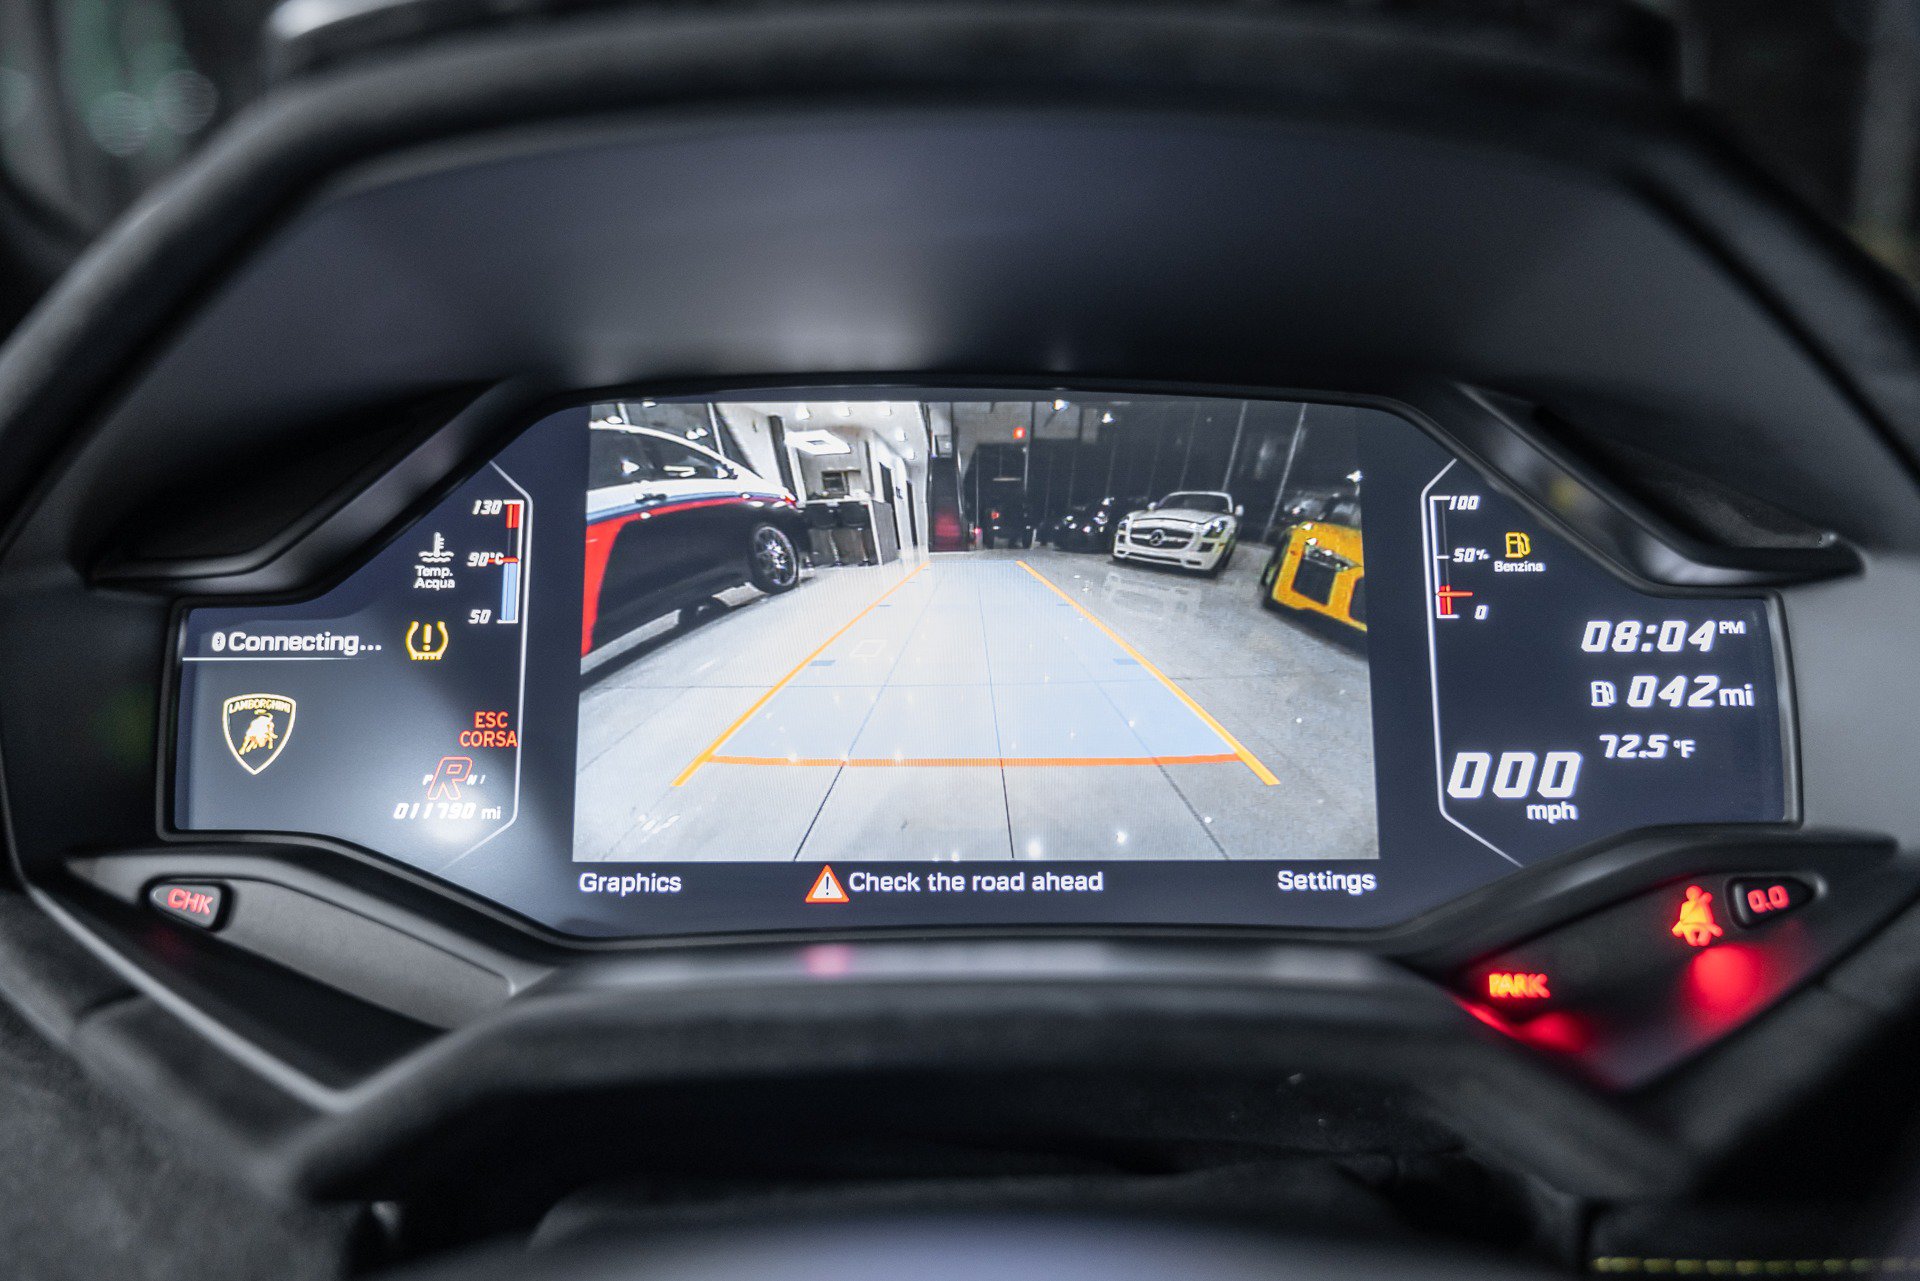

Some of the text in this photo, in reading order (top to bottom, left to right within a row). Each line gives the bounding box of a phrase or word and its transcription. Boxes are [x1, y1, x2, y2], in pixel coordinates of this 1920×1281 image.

[472, 499, 502, 515] 130
[1449, 495, 1480, 511] 100
[1453, 547, 1489, 563] 50%
[415, 565, 453, 578] Temp.
[1493, 560, 1546, 572] Benzina
[413, 578, 456, 591] Acqua
[468, 609, 491, 624] 50
[1475, 604, 1489, 620] 0
[228, 631, 382, 656] Connecting...
[1581, 620, 1747, 652] 08:04 PM
[1626, 675, 1755, 707] 042 mi
[229, 699, 291, 714] LAMBORGHINI
[474, 711, 509, 729] ESC
[459, 730, 518, 748] CORSA
[1599, 734, 1669, 758] 72.5
[427, 756, 473, 801] R
[1447, 752, 1583, 798] 000
[393, 802, 502, 820] 011790 mi
[1526, 801, 1579, 824] mph
[579, 872, 682, 897] Graphics
[849, 871, 1104, 892] Check the road ahead
[1277, 870, 1377, 895] Settings
[168, 888, 214, 915] CHK
[1488, 973, 1550, 998] PARK
